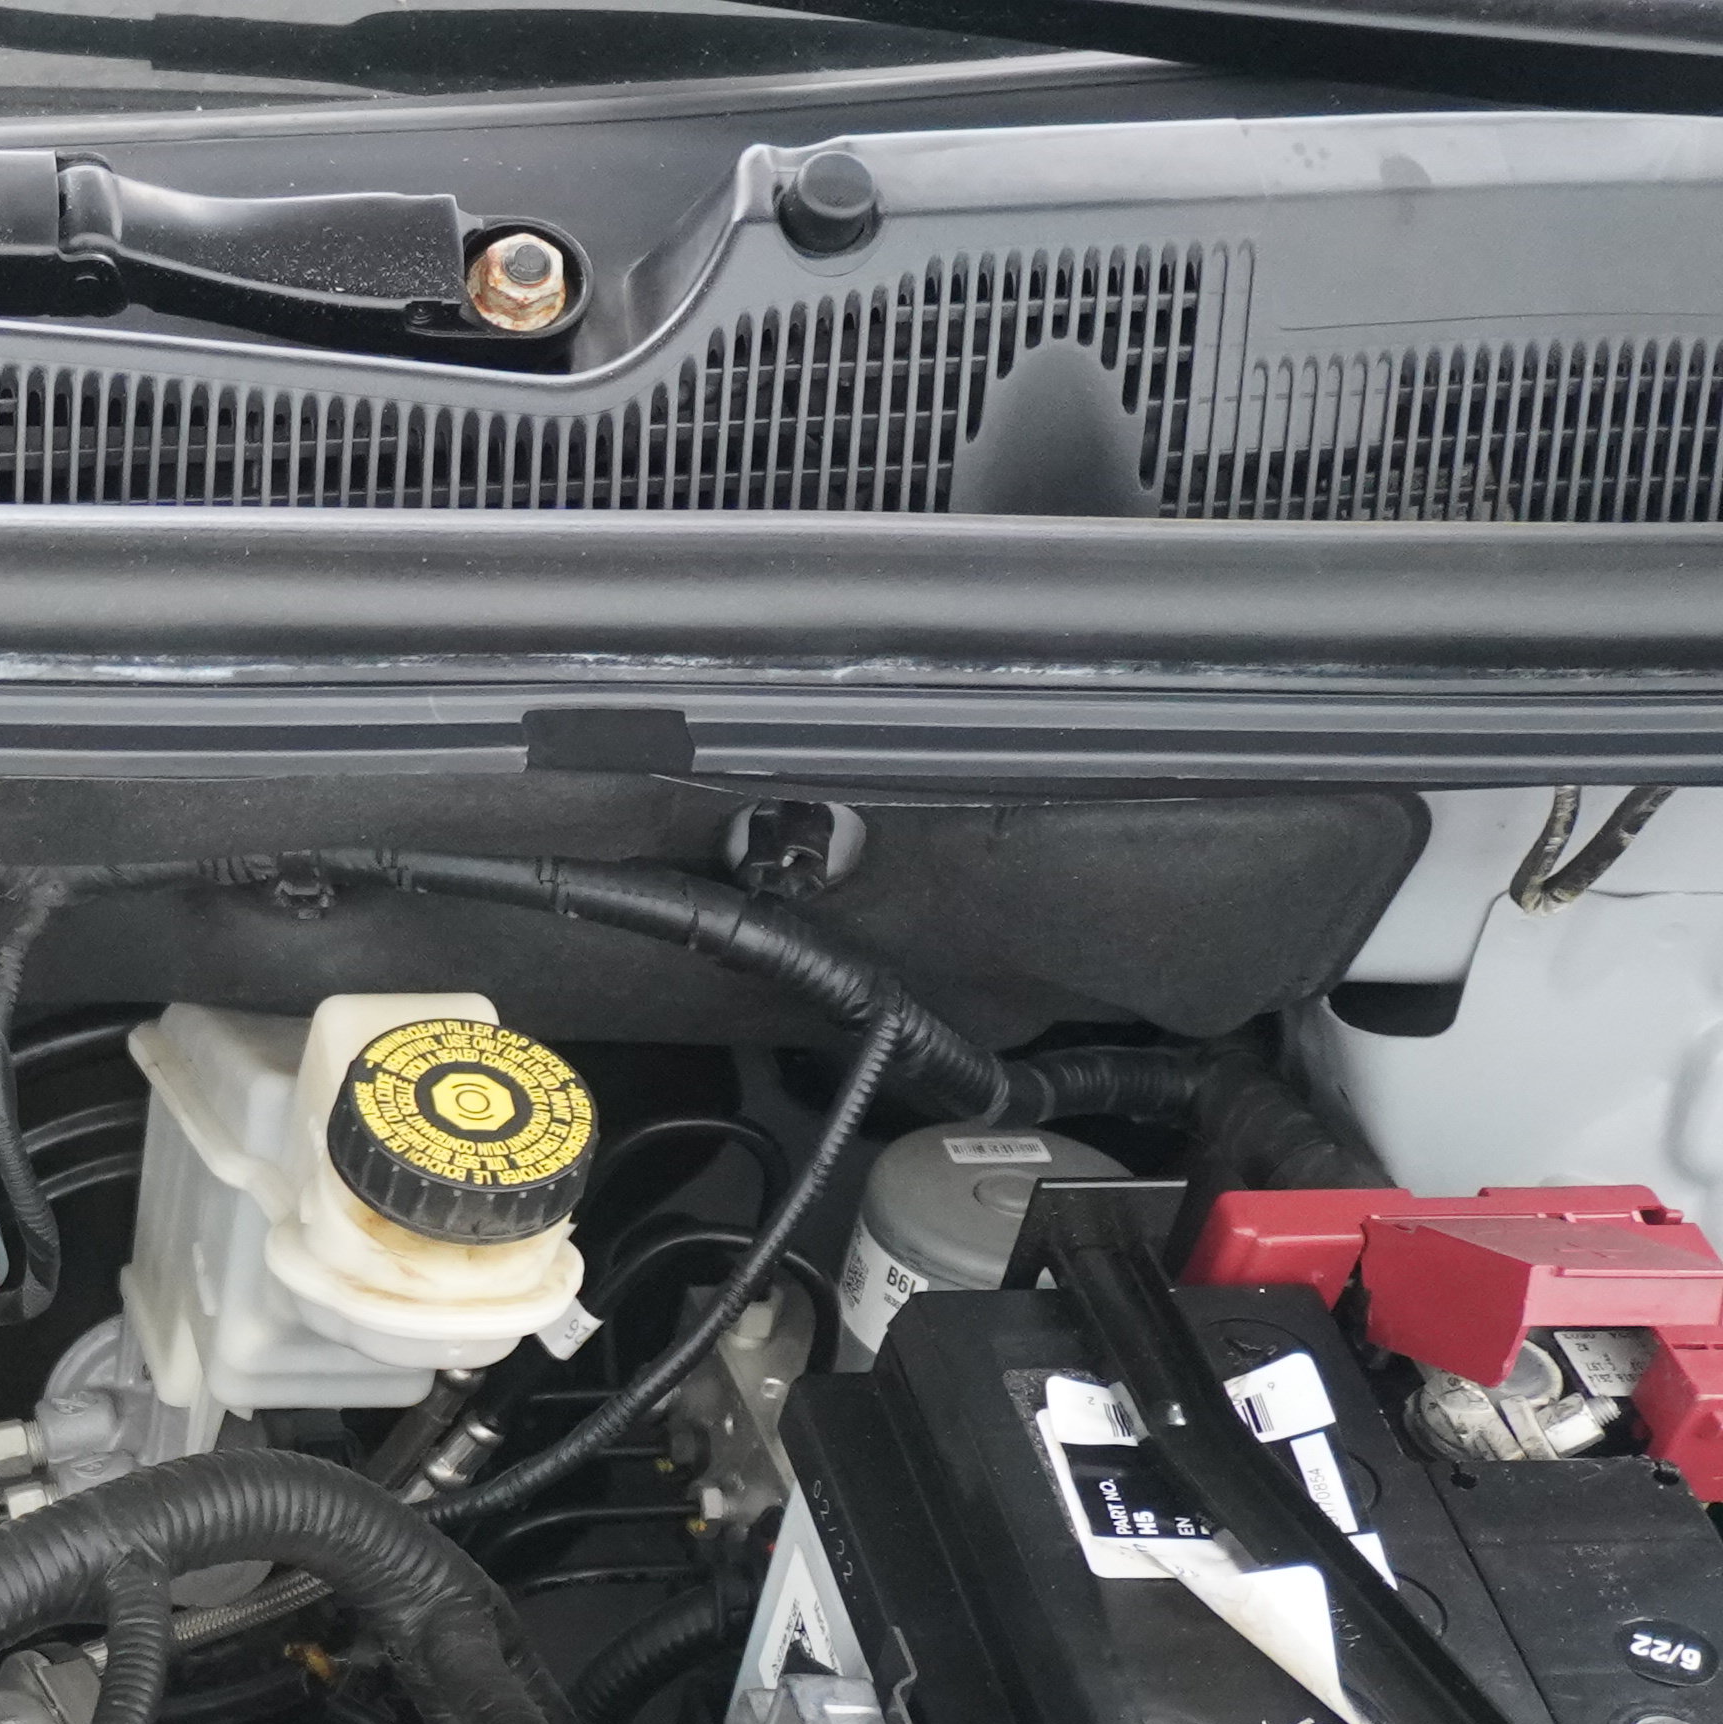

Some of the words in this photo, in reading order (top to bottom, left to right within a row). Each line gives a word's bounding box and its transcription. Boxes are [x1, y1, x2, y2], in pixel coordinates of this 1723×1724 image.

[424, 1052, 441, 1066] A
[432, 1046, 480, 1063] SEALED
[439, 1033, 471, 1049] USE
[472, 1034, 506, 1055] ONLY
[502, 1045, 530, 1064] DOT
[527, 1062, 561, 1090] FLUID
[444, 1020, 494, 1039] FILLER
[496, 1029, 529, 1051] CAP
[526, 1044, 575, 1081] BEFORE
[399, 1056, 432, 1081] FROM
[525, 1087, 552, 1105] DOT
[377, 1106, 403, 1123] DU
[405, 1114, 476, 1156] CONTENANT
[547, 1121, 570, 1138] DE
[384, 1134, 410, 1153] DE
[404, 1148, 467, 1181] BOUCHON
[472, 1169, 492, 1185] LE
[1100, 1478, 1122, 1502] NO.
[1106, 1499, 1134, 1536] PART
[1630, 1632, 1702, 1671] 6/22
